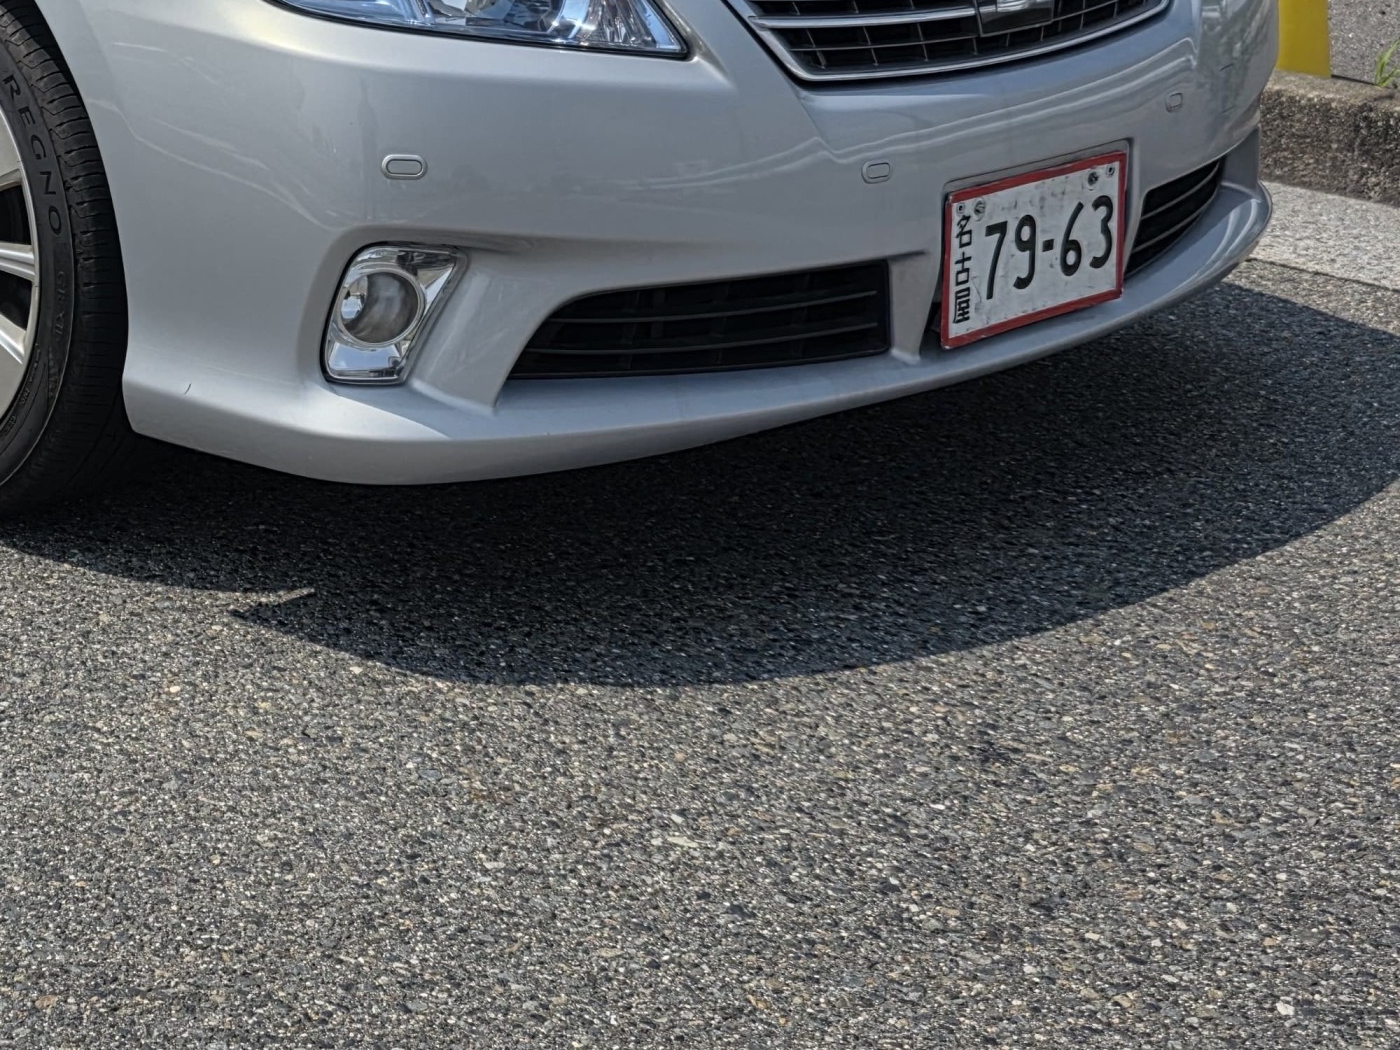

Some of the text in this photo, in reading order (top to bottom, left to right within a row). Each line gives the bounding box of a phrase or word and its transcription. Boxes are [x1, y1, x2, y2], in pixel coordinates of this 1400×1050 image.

[2, 75, 62, 236] REGNO
[953, 214, 973, 324] 名古屋
[984, 194, 1114, 301] 79-63
